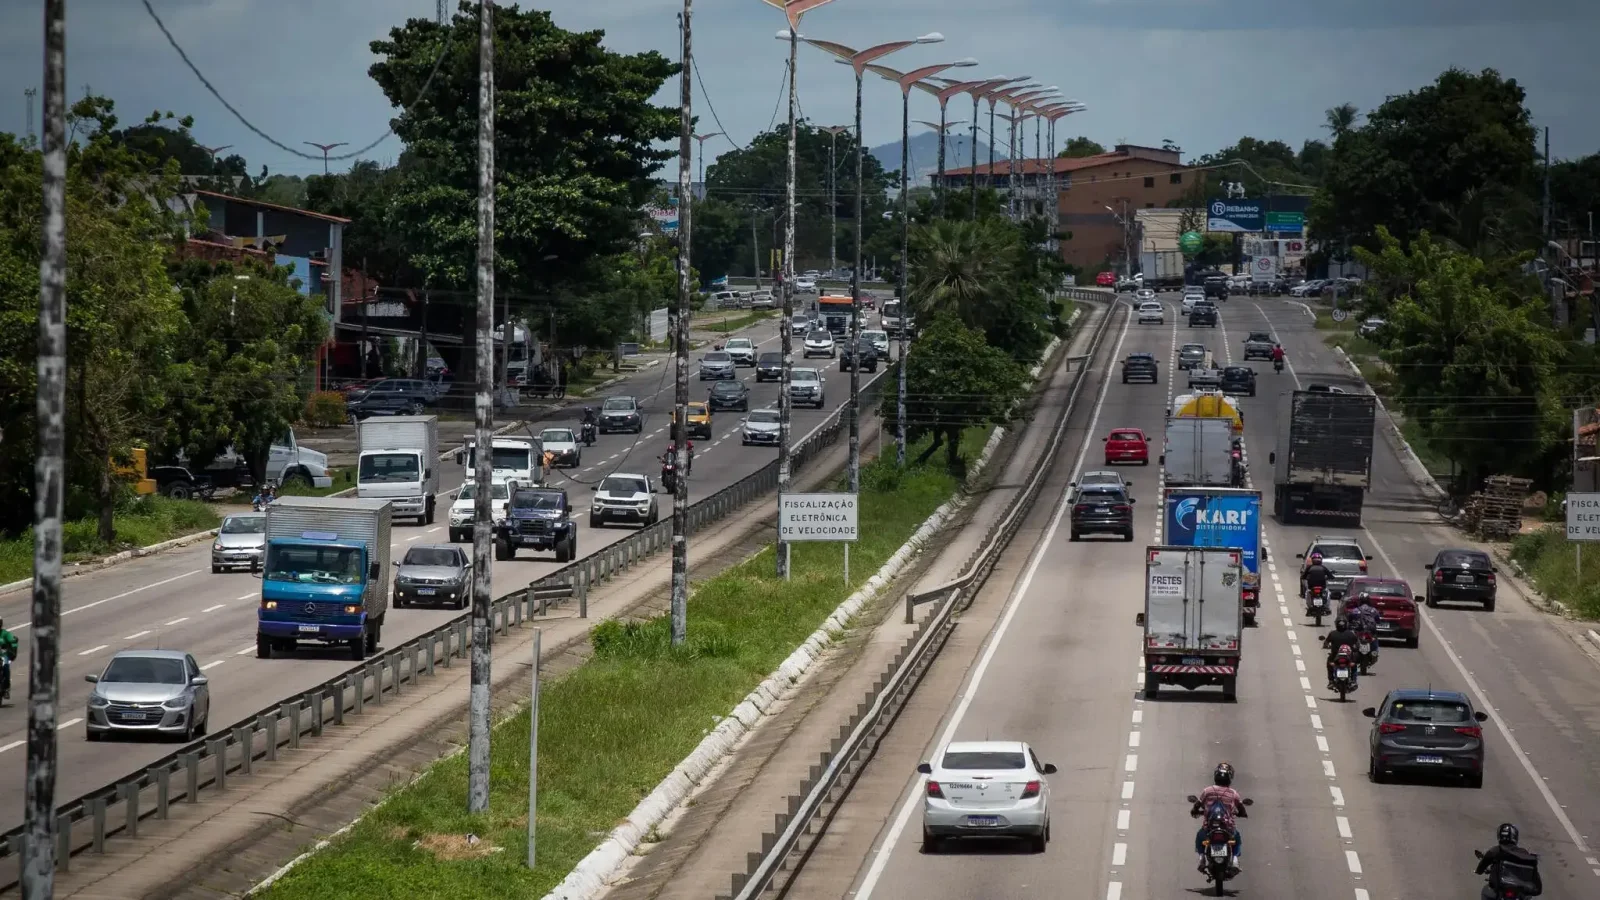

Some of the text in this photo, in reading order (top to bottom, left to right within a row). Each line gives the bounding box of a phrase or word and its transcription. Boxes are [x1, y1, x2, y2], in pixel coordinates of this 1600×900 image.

[784, 499, 854, 510] FISCALIZAÇÃO
[1571, 500, 1600, 508] FISCA
[790, 513, 848, 522] ELETRÔNICA
[1196, 509, 1247, 525] KARI
[1577, 514, 1600, 522] ELET
[782, 526, 856, 534] DE VELOCIDADE
[1568, 526, 1580, 534] DE
[1152, 576, 1182, 585] FRETES
